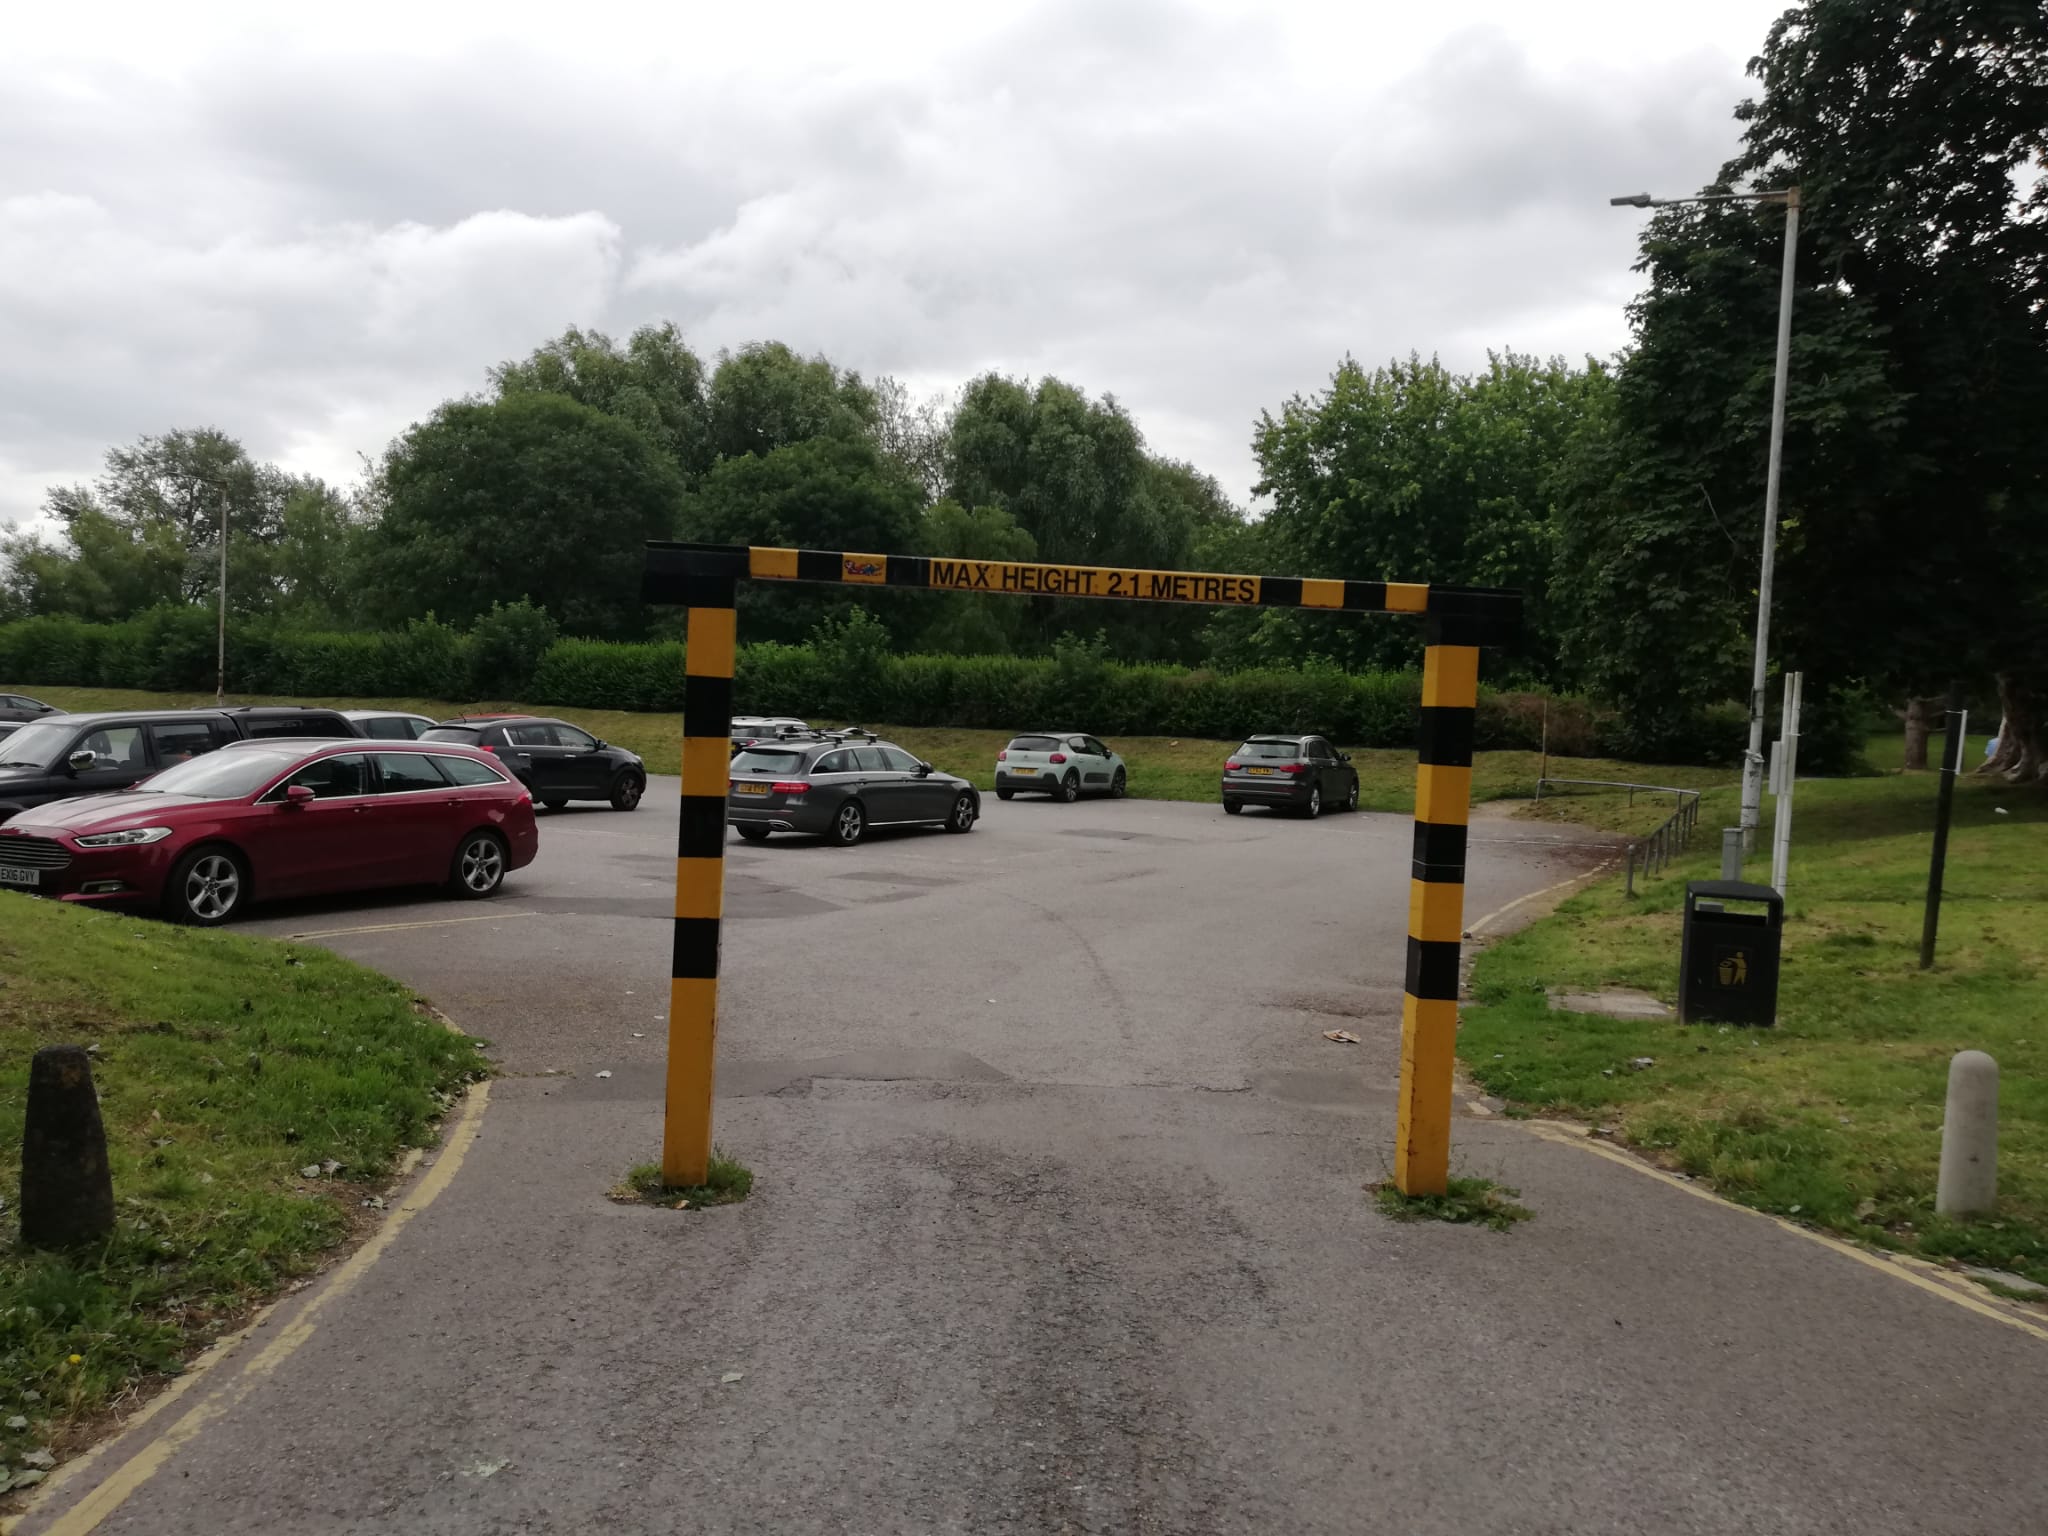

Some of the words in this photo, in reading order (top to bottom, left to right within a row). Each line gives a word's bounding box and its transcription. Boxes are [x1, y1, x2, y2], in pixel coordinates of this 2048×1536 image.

[932, 561, 990, 588] MAX
[1001, 565, 1097, 593] HEIGHT
[1107, 571, 1140, 597] 2.1
[1151, 573, 1254, 601] METRES
